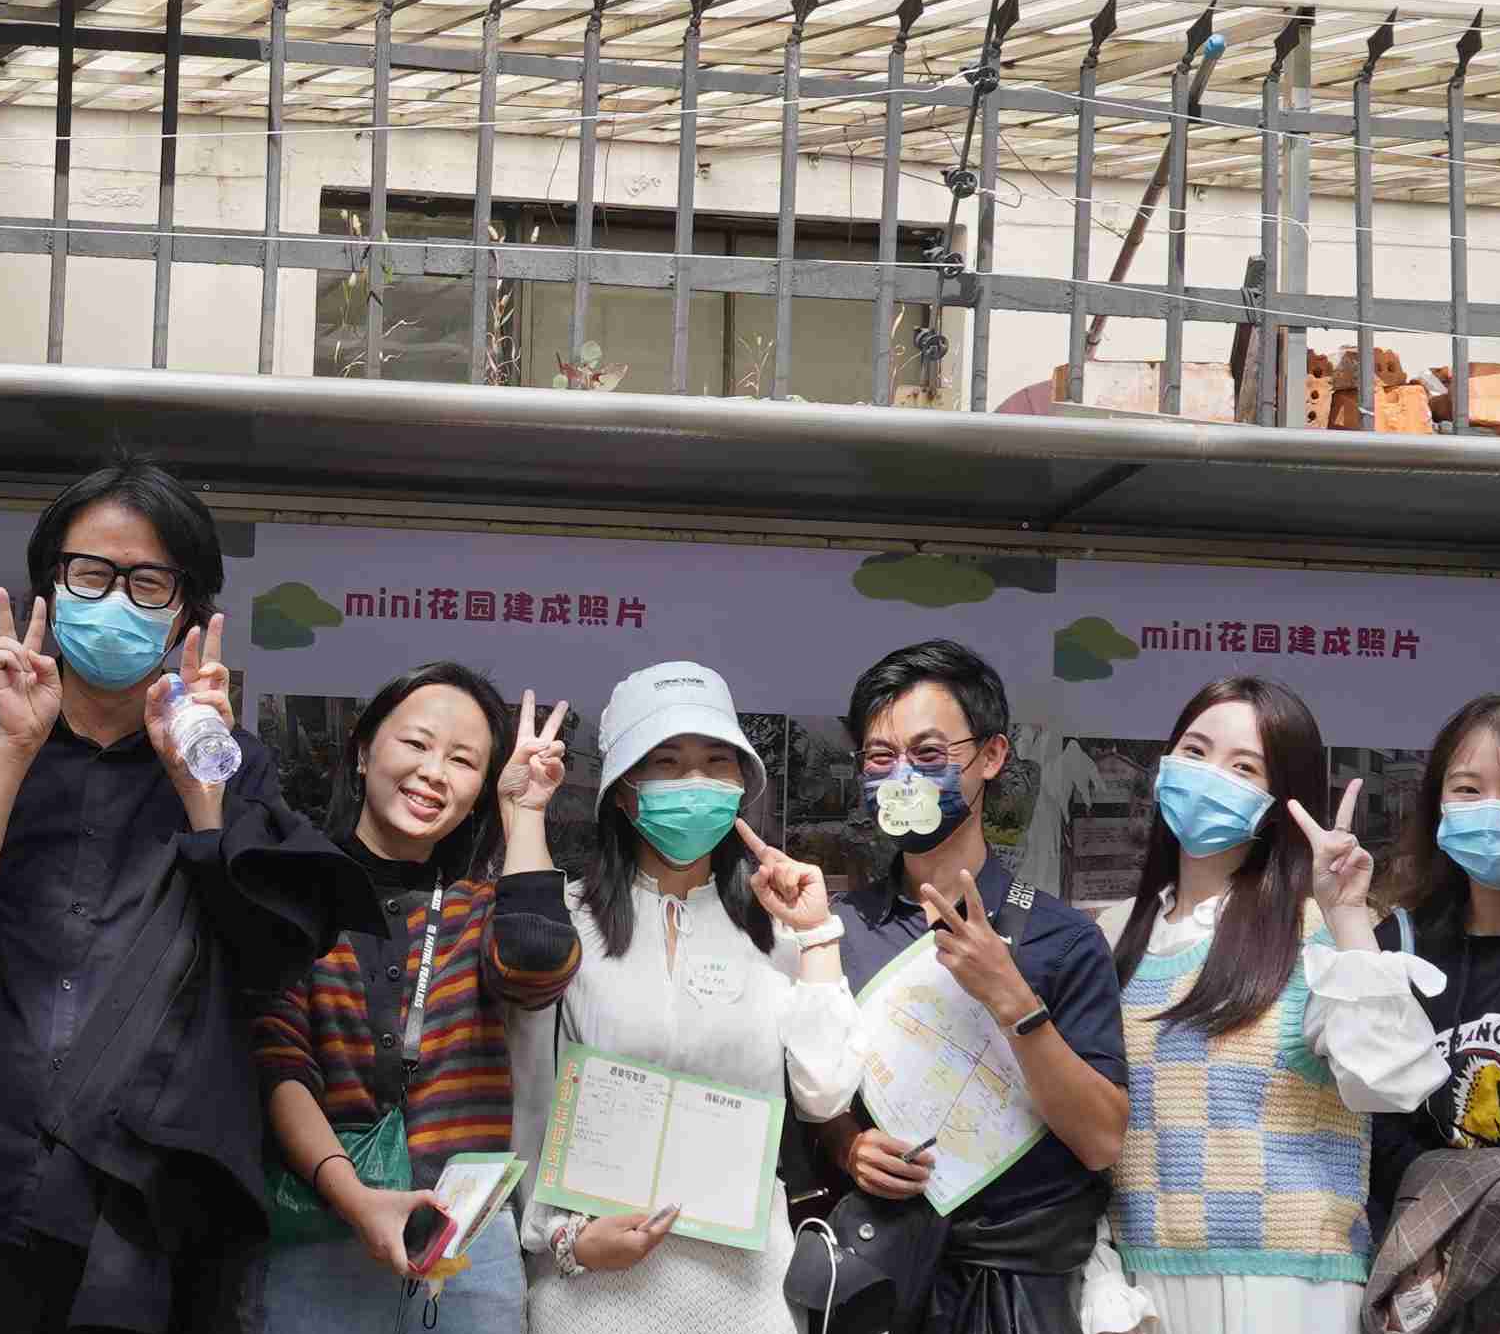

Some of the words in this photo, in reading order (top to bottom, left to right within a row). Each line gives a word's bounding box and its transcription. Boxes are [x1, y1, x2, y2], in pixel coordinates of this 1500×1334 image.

[344, 587, 647, 628] mini花园建成照片
[1141, 620, 1421, 659] mini花园建成照片
